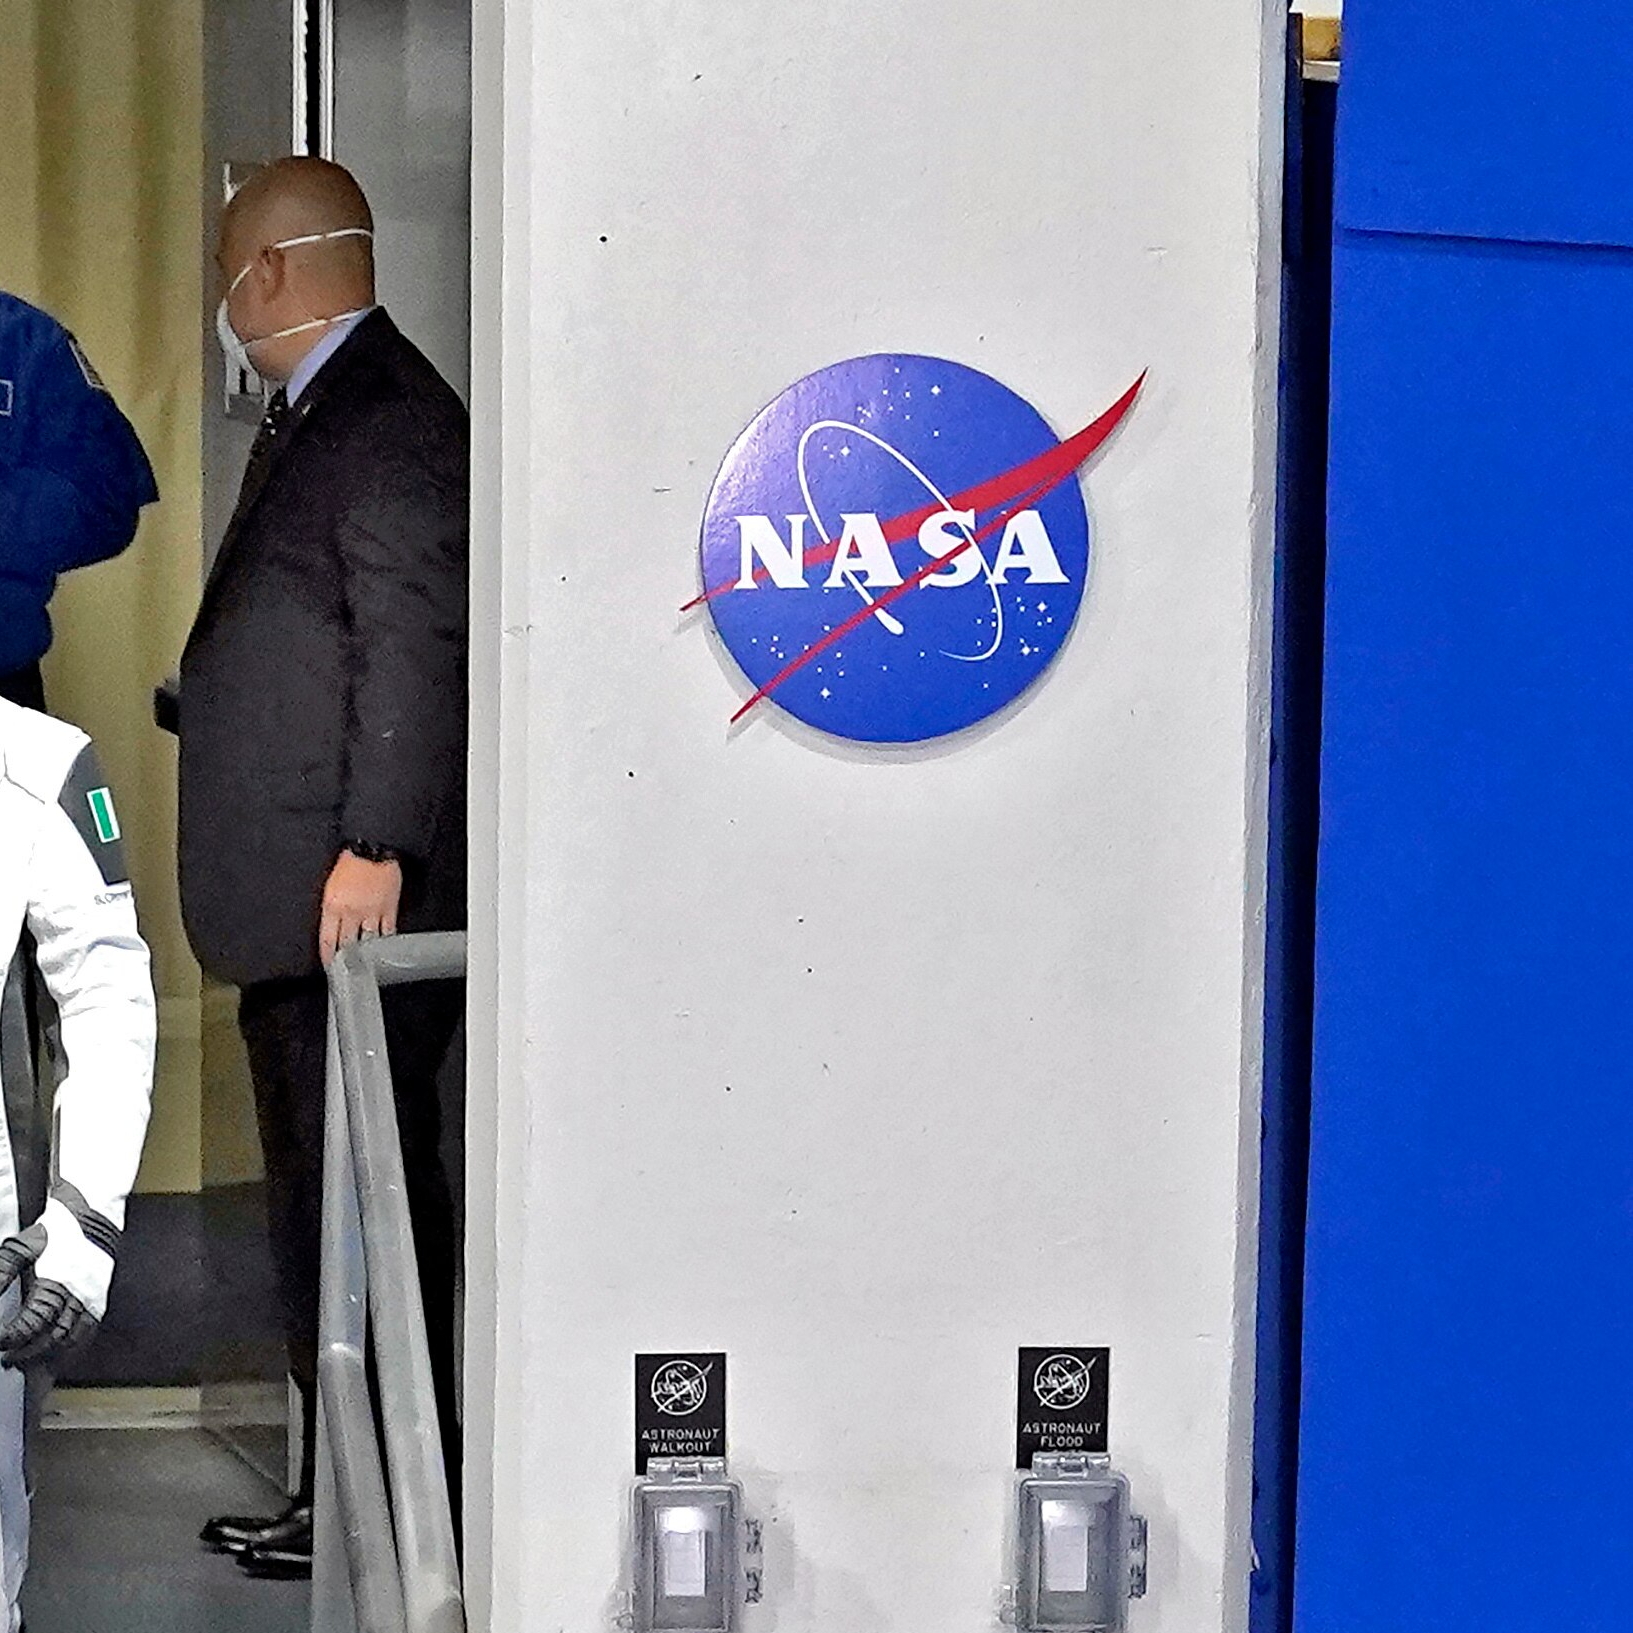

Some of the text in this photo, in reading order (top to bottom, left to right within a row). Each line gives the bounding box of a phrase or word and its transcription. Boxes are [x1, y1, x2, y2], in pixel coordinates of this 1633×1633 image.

[733, 508, 1071, 590] NASA
[641, 1427, 721, 1440] ASTRONAUT
[1022, 1422, 1101, 1435] ASTRONAUT
[649, 1441, 711, 1454] WALKOUT
[1040, 1435, 1084, 1447] FLOOD
